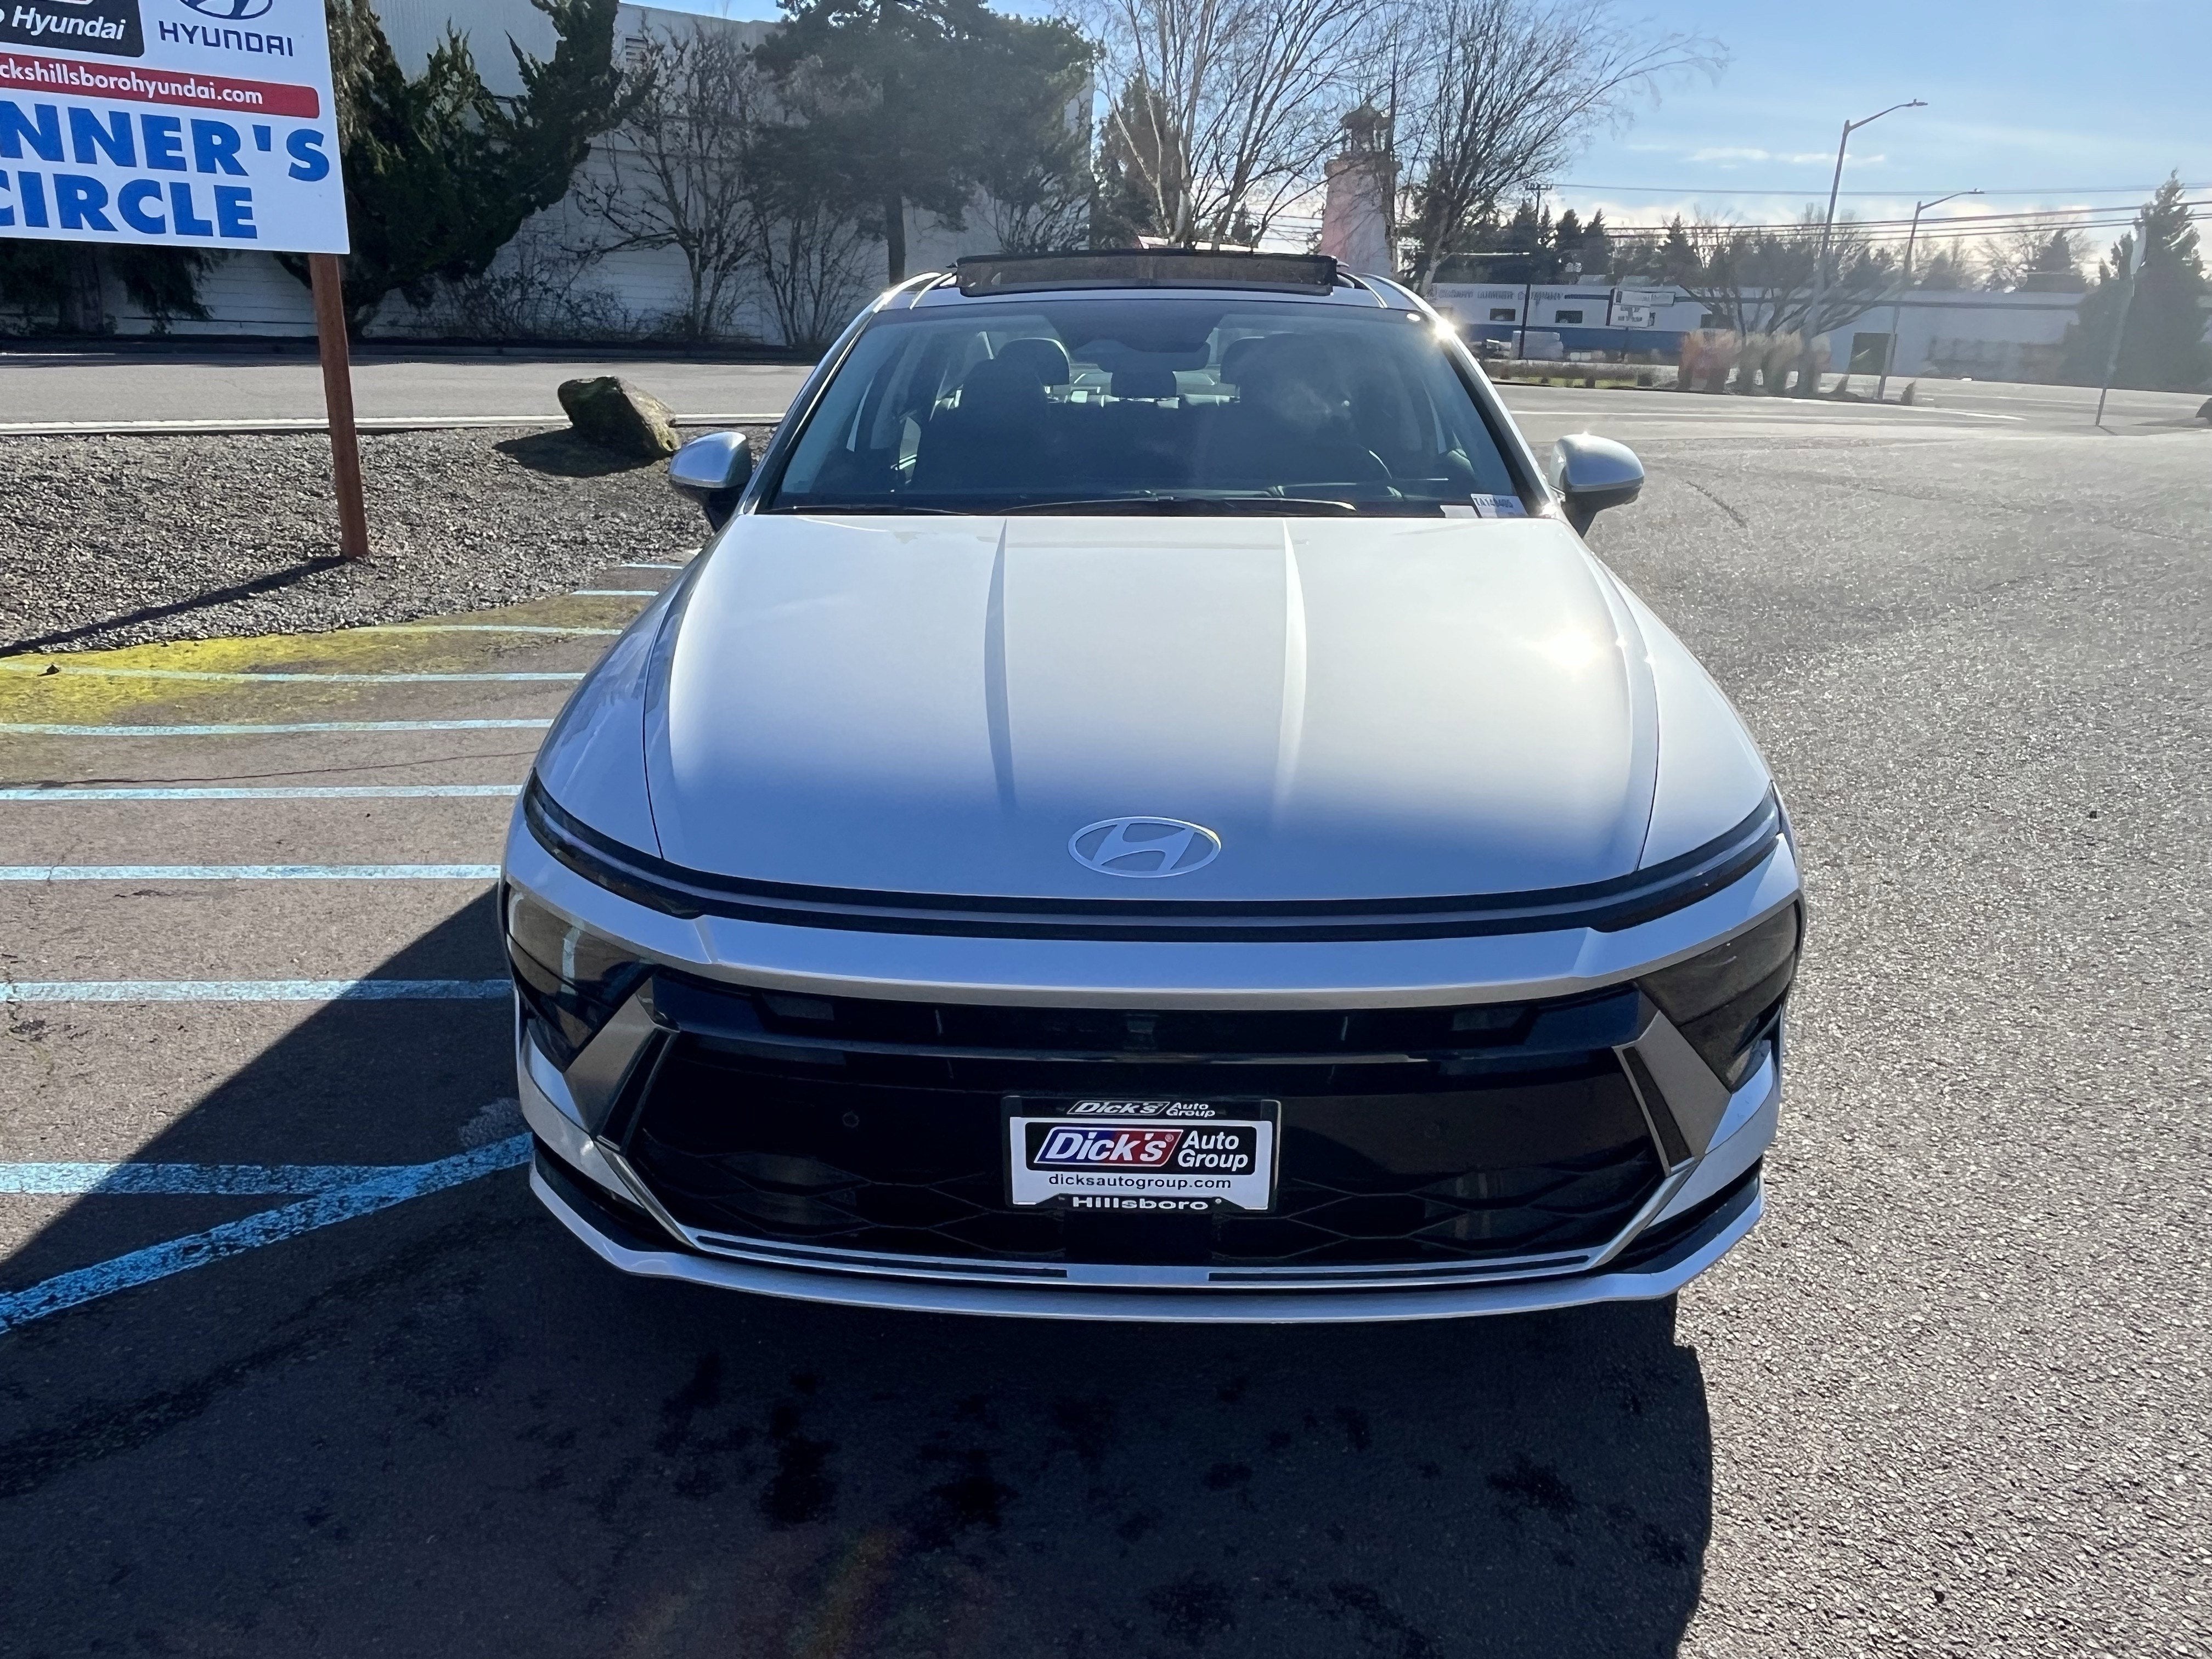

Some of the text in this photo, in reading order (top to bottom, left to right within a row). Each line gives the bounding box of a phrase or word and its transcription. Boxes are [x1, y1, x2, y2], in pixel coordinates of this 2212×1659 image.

[12, 5, 126, 40] Hyundai
[159, 21, 293, 57] HYUNDAI
[1166, 1108, 1216, 1118] Group
[1182, 1130, 1239, 1149] Auto
[1177, 1149, 1249, 1172] Group
[1048, 1173, 1232, 1190] dicksautogroup.com
[1073, 1197, 1209, 1210] Hillsboro
